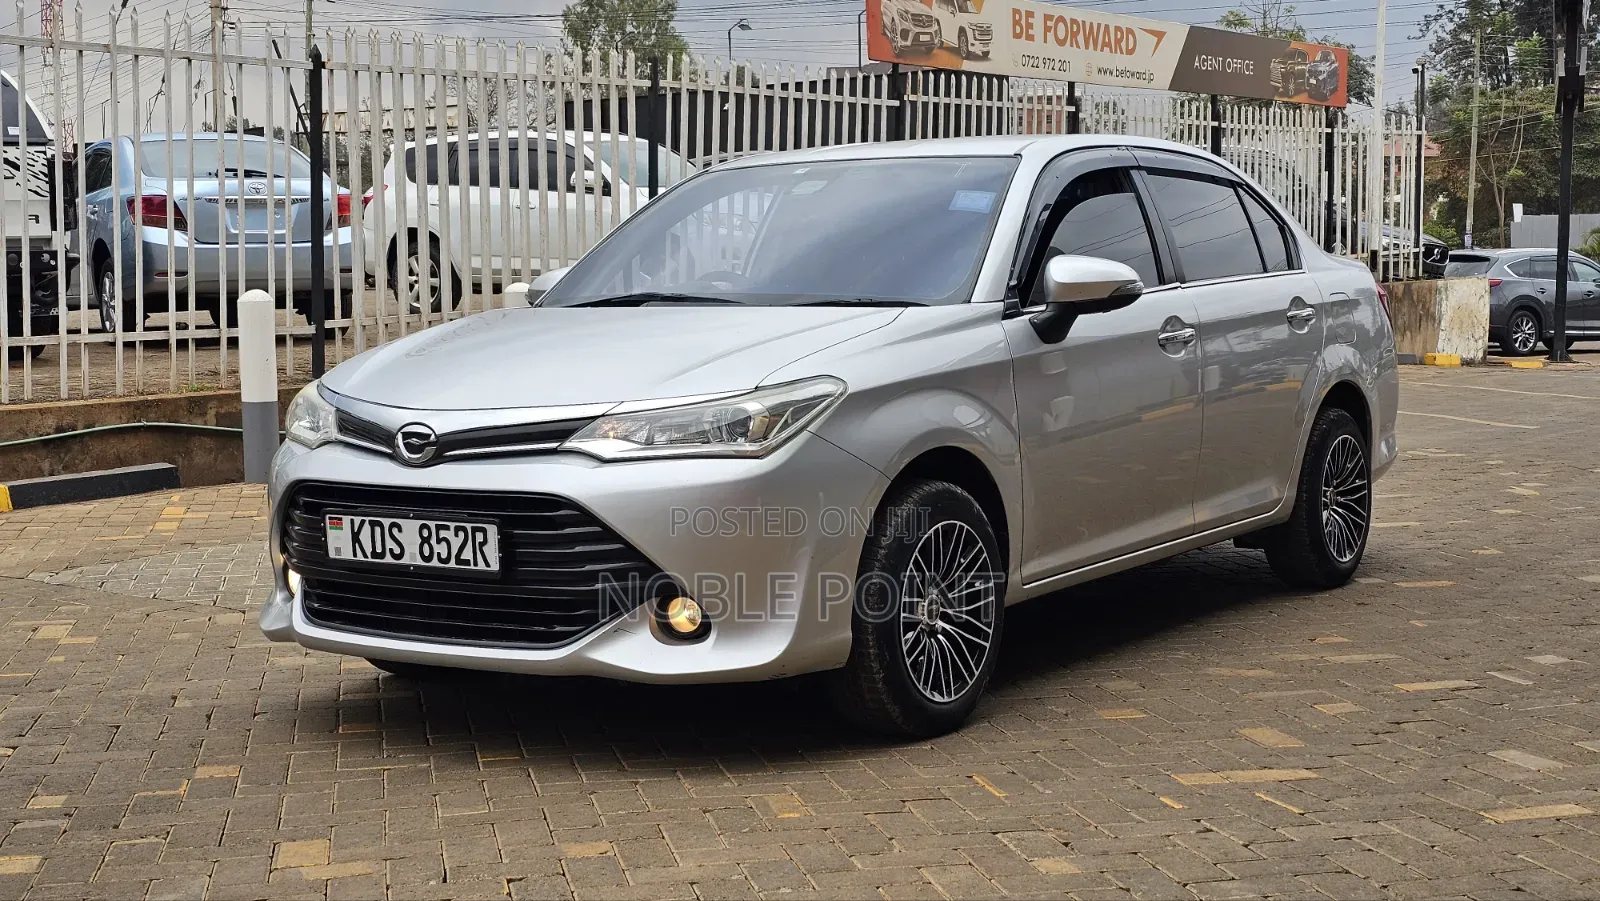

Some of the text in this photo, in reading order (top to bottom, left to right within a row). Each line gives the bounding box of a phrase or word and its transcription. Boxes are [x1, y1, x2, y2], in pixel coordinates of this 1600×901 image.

[1012, 8, 1138, 56] BE FORWARD
[1021, 54, 1071, 73] 0722 972 201
[1194, 54, 1254, 75] AGENT OFFICE
[350, 518, 405, 560] KDS
[418, 523, 491, 568] 852R
